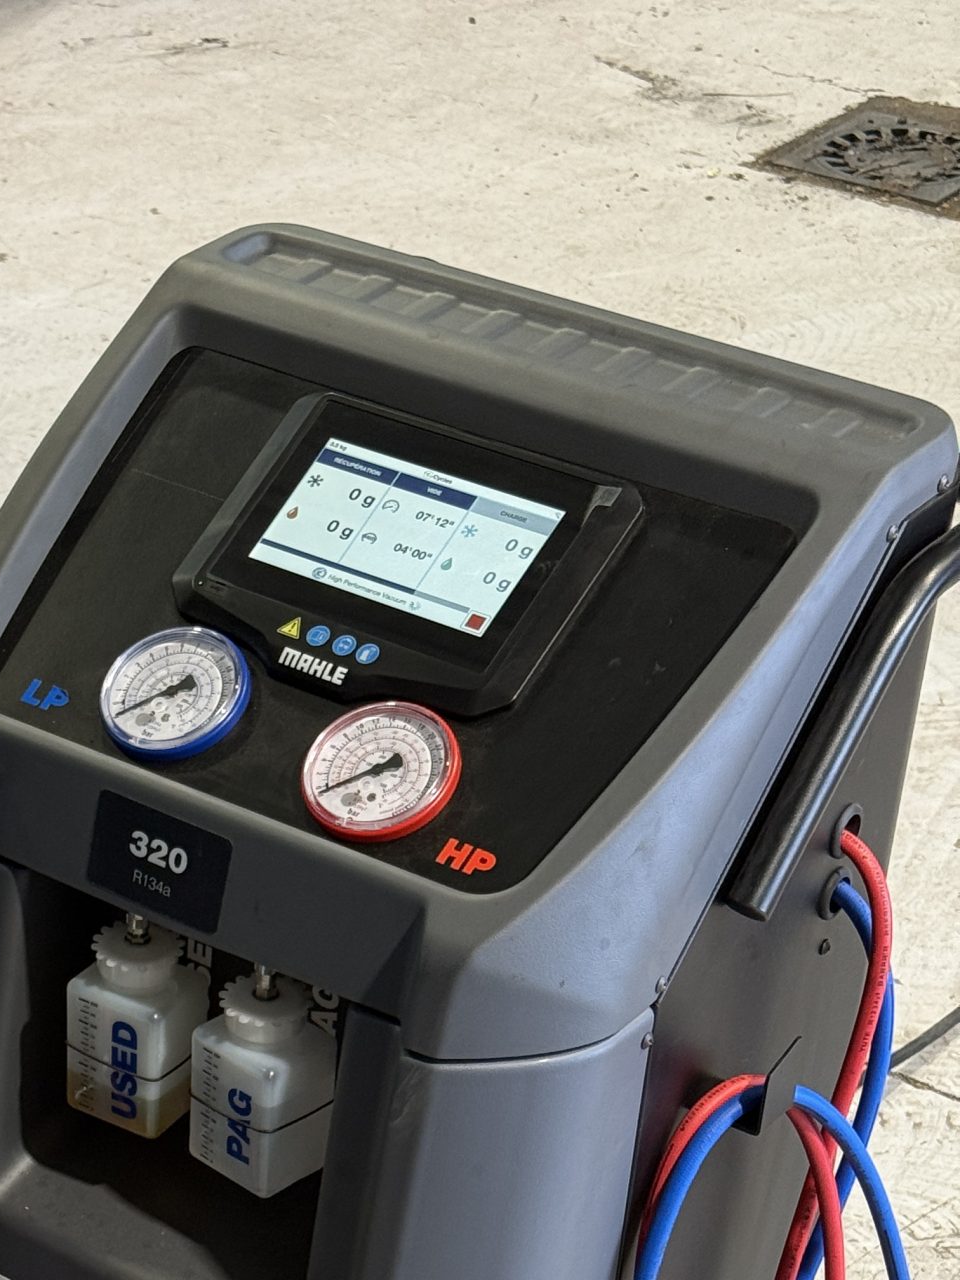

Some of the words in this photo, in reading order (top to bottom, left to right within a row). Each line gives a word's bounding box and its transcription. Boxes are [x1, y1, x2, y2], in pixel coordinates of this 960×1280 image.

[349, 488, 361, 500] 0
[361, 495, 376, 508] g
[327, 520, 339, 532] 0
[339, 527, 354, 540] g
[500, 510, 528, 523] CHARGE
[505, 538, 518, 551] 0
[518, 546, 533, 559] g
[328, 573, 342, 583] High
[344, 579, 381, 596] Performance
[382, 592, 407, 604] Vacuum
[483, 571, 496, 584] 0
[496, 579, 511, 592] g
[278, 646, 348, 686] MAHLE
[20, 678, 70, 710] LP
[129, 830, 189, 874] 320
[435, 837, 497, 875] HP
[133, 870, 172, 897] R134a
[111, 1021, 138, 1120] USED
[226, 1088, 253, 1166] PAG
